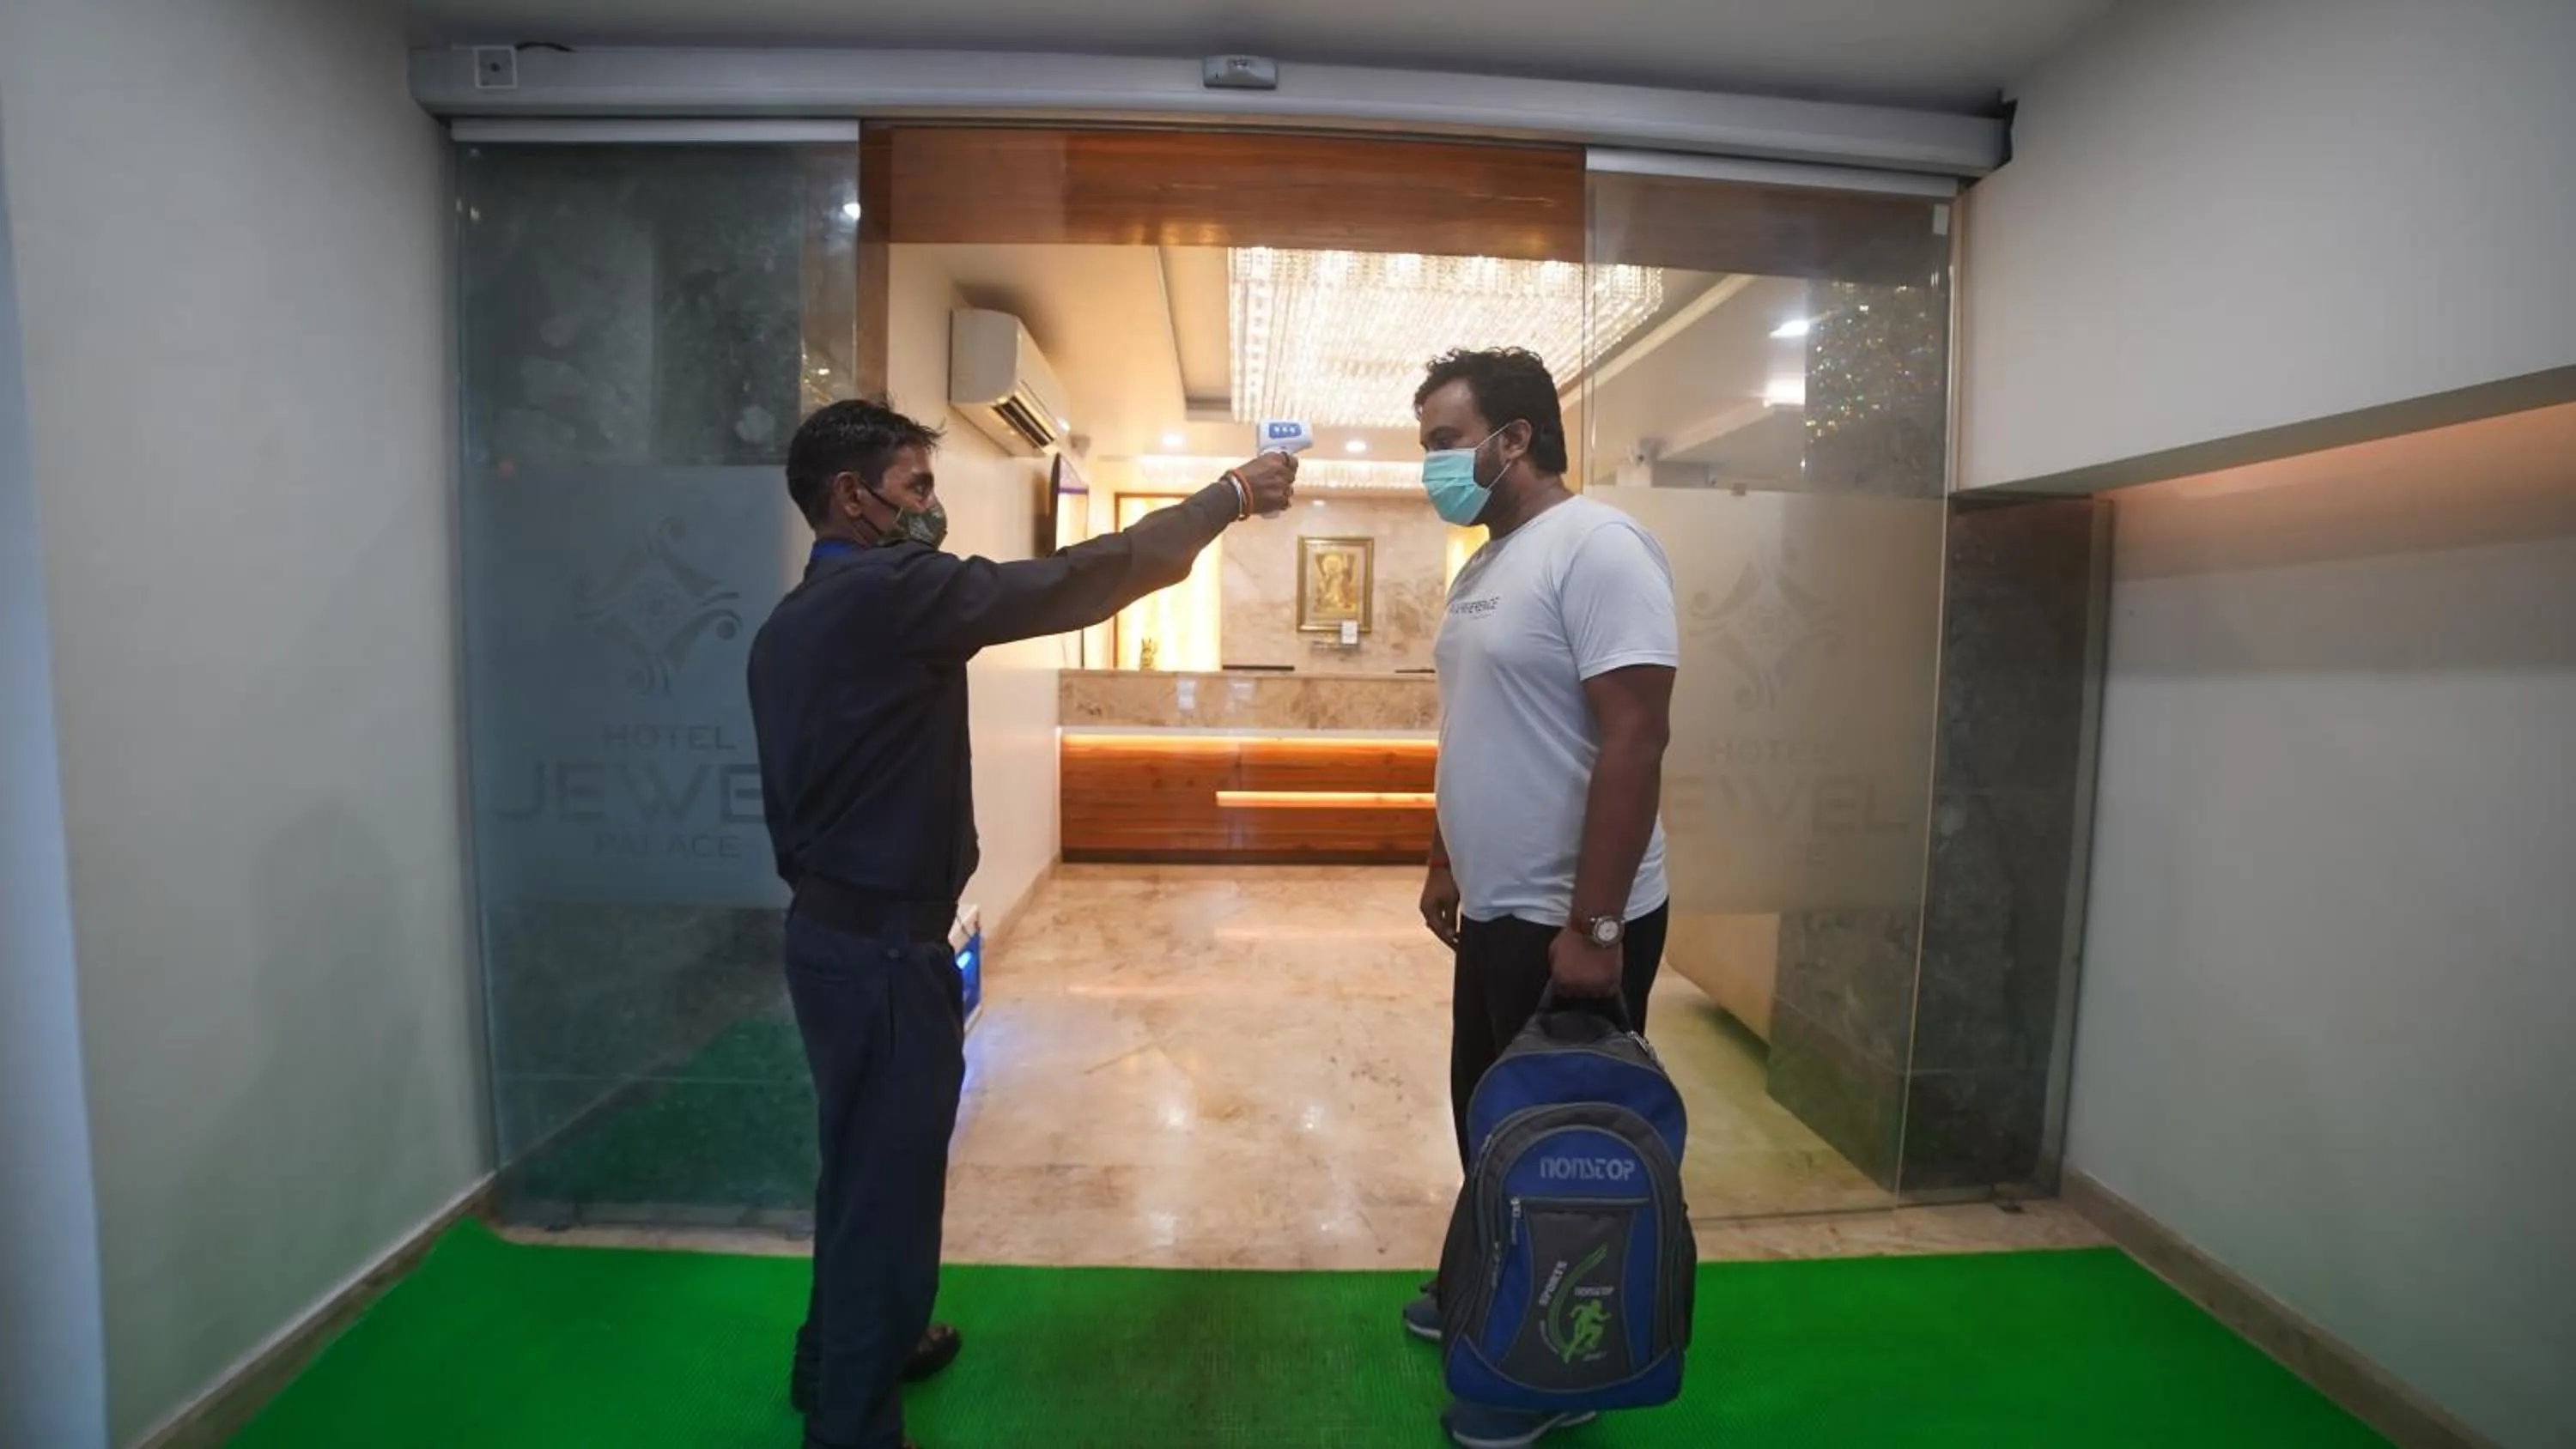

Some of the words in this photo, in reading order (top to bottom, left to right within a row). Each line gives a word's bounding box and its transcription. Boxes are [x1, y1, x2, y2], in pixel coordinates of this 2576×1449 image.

[603, 724, 737, 750] HOTEL
[1706, 738, 1830, 764] HOTEL
[496, 761, 767, 824] JEWE
[1662, 774, 1910, 834] EWEL
[594, 830, 743, 858] PALACE
